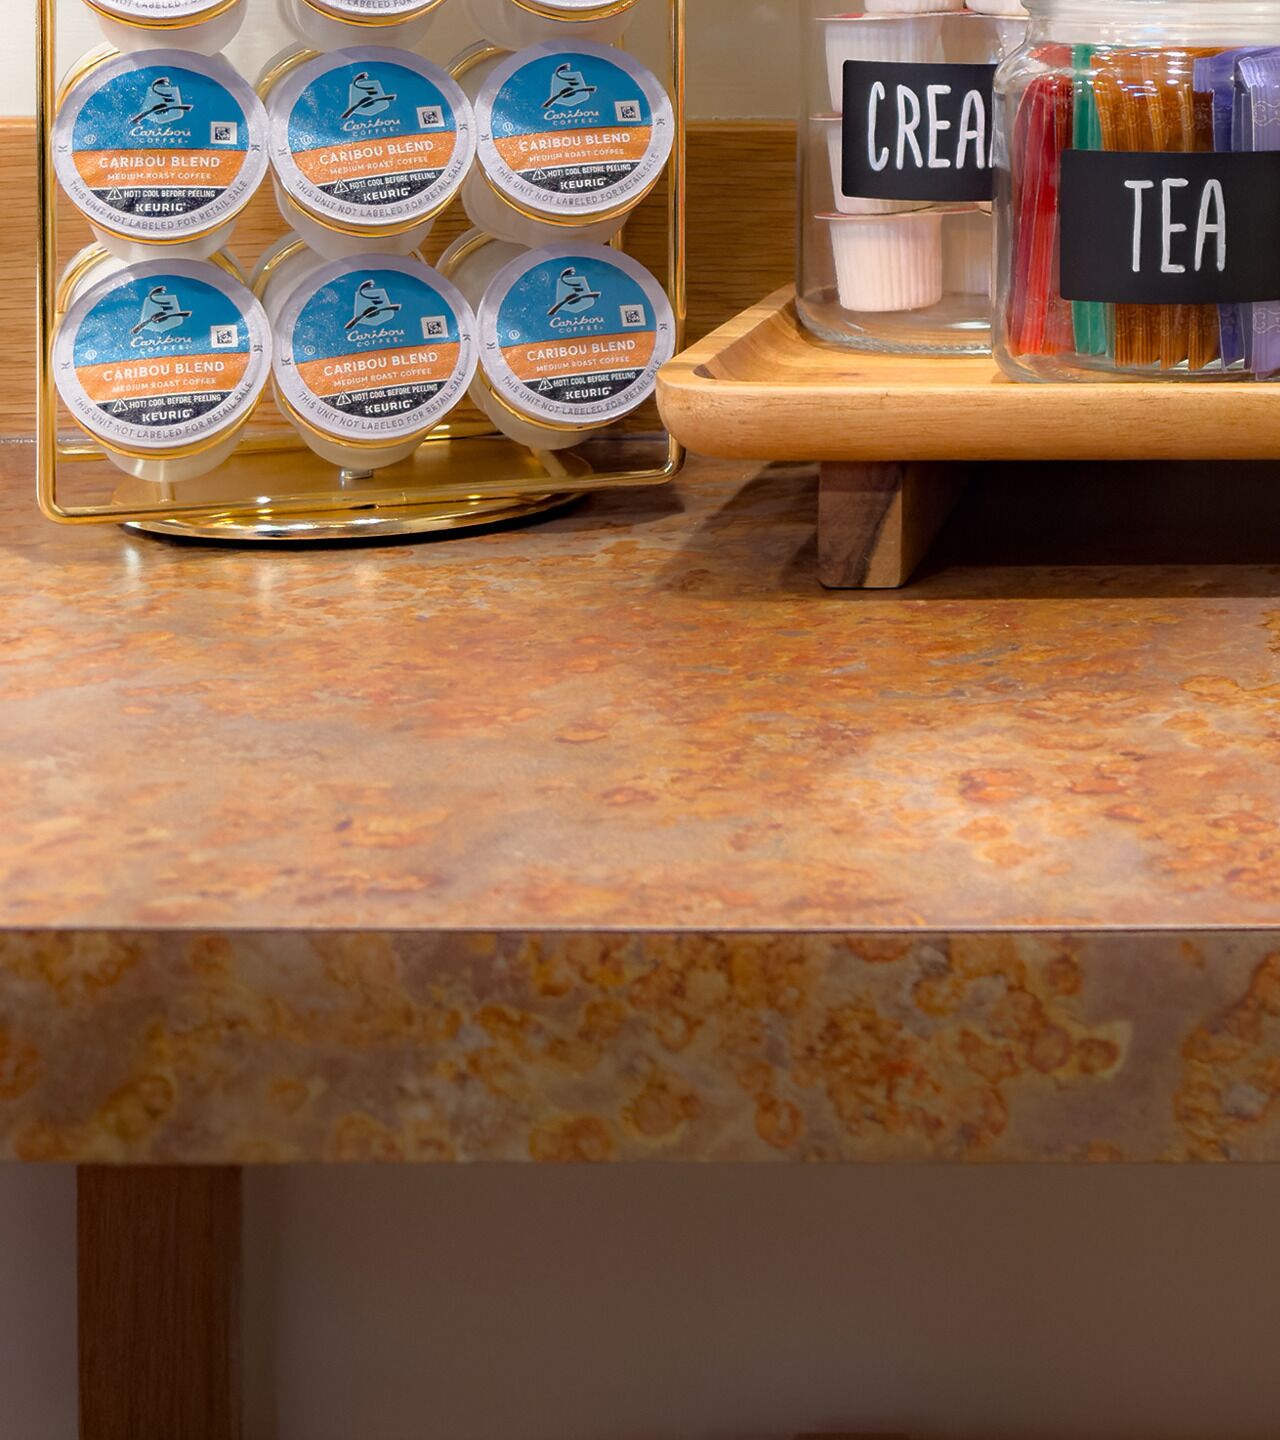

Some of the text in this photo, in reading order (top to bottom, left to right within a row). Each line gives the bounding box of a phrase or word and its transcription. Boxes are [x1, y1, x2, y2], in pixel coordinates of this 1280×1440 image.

[543, 109, 600, 121] Caribou
[130, 126, 192, 137] Caribou
[342, 118, 401, 132] Caribou
[867, 81, 994, 172] CREA
[519, 132, 631, 151] CARIBOU BLEND
[319, 140, 434, 165] CARIBOU BLEND
[99, 155, 221, 169] CARIBOU BLEND
[107, 172, 211, 181] MEDIUM ROAST COFFEE
[560, 178, 605, 190] KEURIG
[124, 190, 141, 198] HOT!
[142, 190, 160, 198] COOL
[161, 189, 186, 197] BEFORE
[363, 188, 409, 202] KEURIG
[69, 180, 249, 231] THIS UNIT NOT LABELED FOR RETAIL SALE
[136, 203, 184, 212] KEURIG
[1124, 178, 1227, 273] TEA
[549, 315, 604, 328] Caribou
[130, 335, 193, 348] Caribou
[347, 328, 405, 342] Caribou
[527, 340, 636, 362] CARIBOU BLEND
[323, 352, 438, 376] CARIBOU BLEND
[102, 361, 225, 382] CARIBOU BLEND
[333, 367, 432, 388] MEDIUM ROAST COFFEE
[299, 369, 466, 430] THIS UNIT NOT LABELED FOR RETAIL SALE
[351, 383, 438, 402] HOT! COOL BEFORE PEELING
[566, 387, 610, 400] KEURIG
[365, 401, 411, 414] KEURIG
[142, 410, 191, 422] KEURIG
